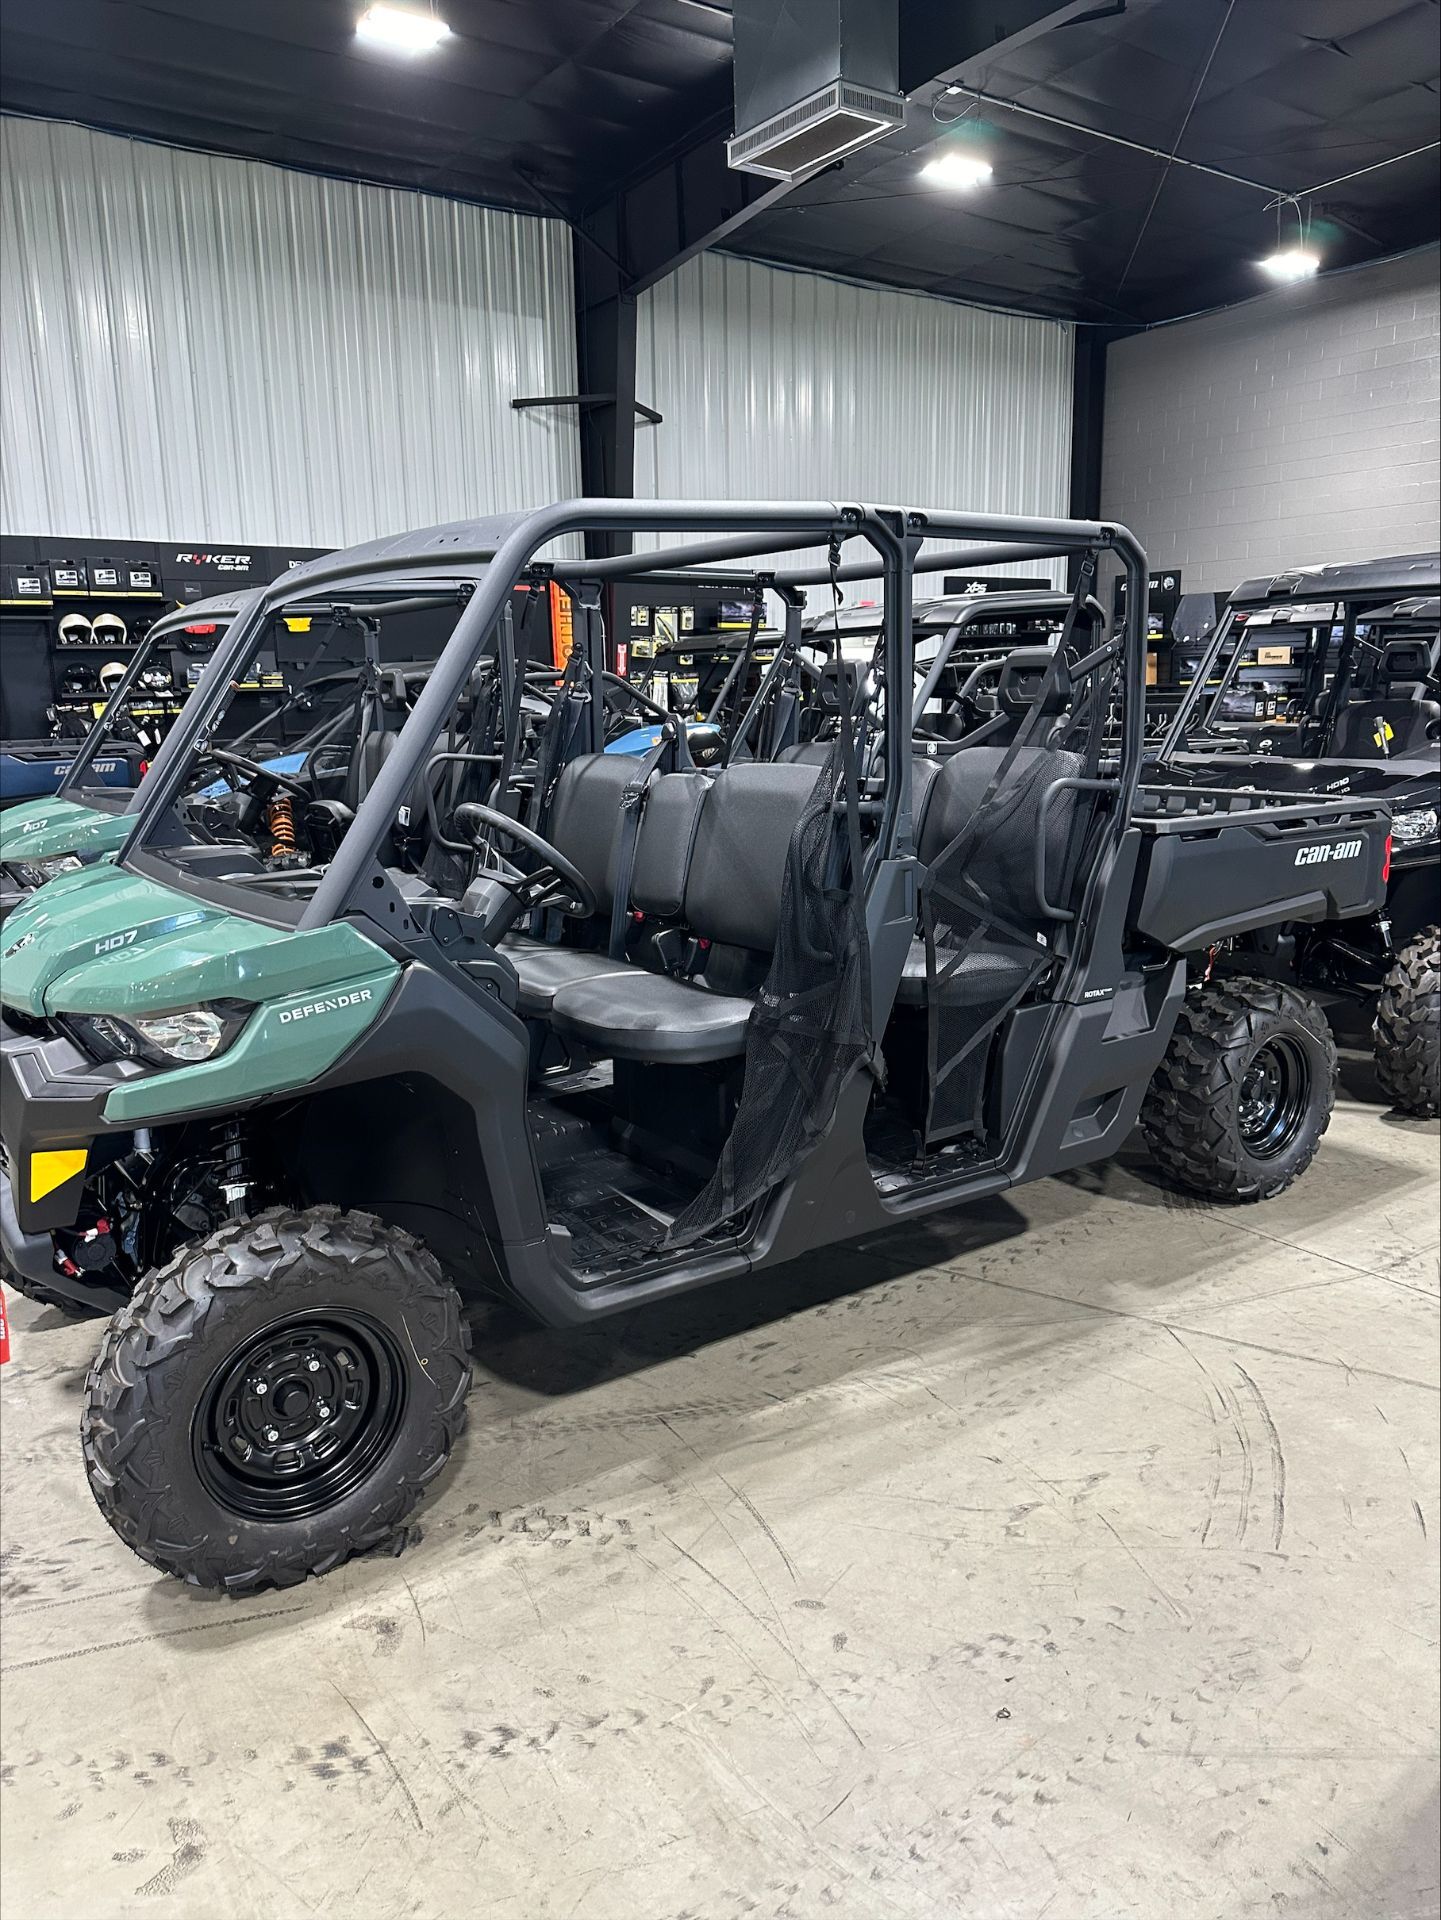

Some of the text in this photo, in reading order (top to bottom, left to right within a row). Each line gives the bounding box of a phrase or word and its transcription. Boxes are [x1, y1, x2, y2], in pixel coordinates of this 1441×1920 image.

[176, 553, 251, 565] RYKER
[964, 582, 988, 593] XPS
[1326, 777, 1350, 791] HD10
[1294, 840, 1362, 866] can-am
[95, 930, 138, 955] HD7
[1084, 989, 1105, 998] ROTAX
[279, 989, 373, 1024] DEFENDER
